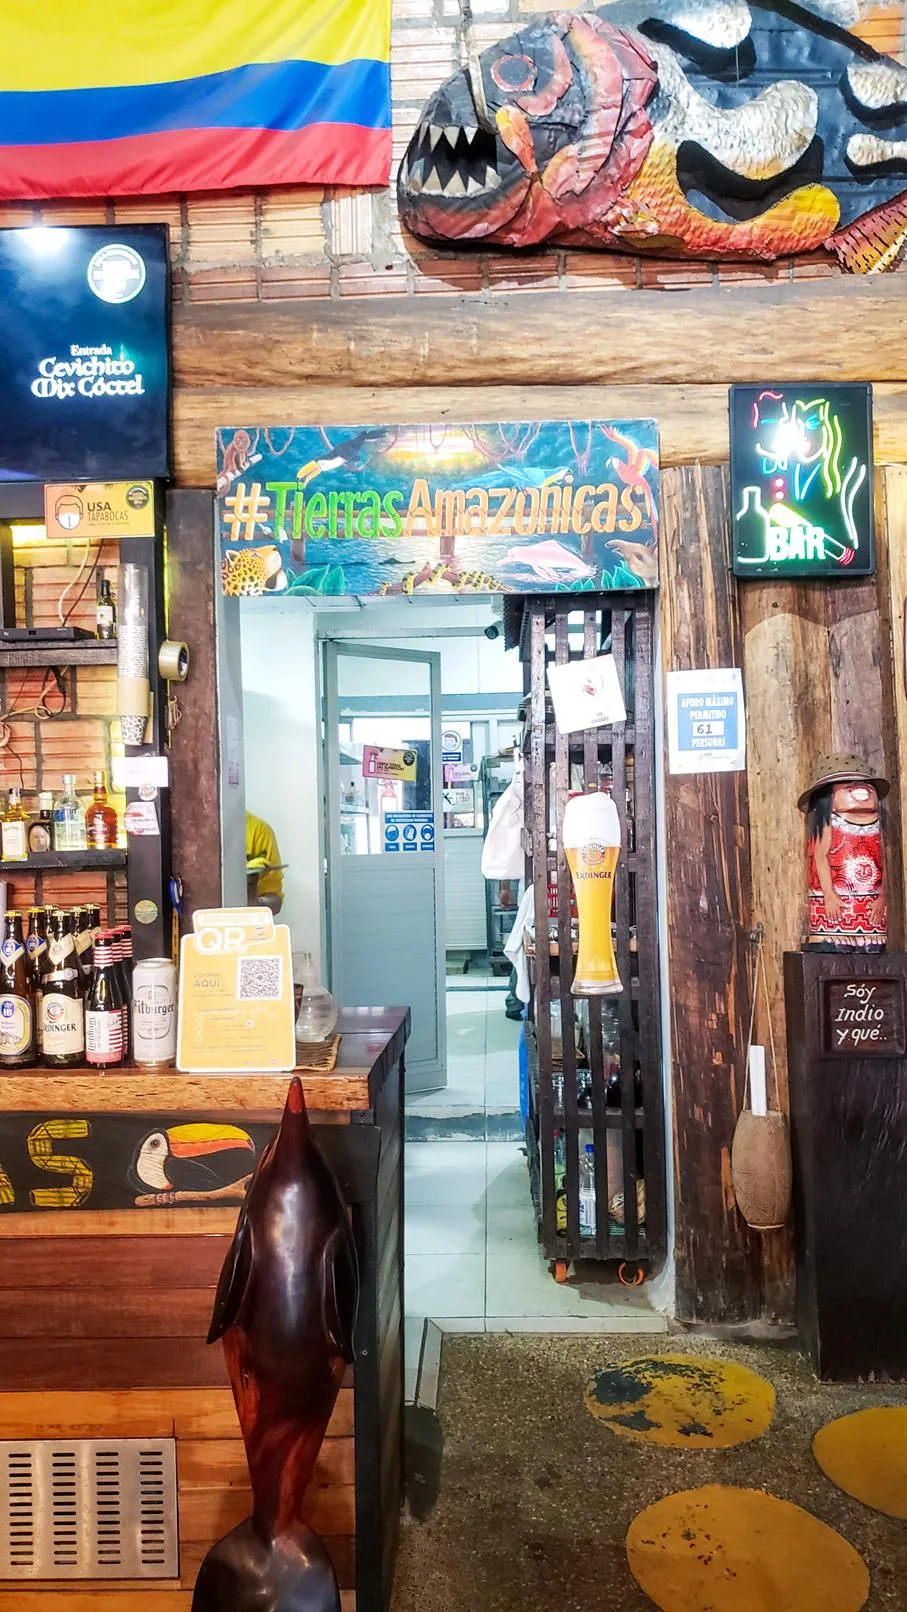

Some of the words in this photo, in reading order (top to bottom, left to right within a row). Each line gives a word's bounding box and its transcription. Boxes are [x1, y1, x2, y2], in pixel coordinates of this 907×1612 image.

[70, 344, 113, 356] Entrada
[30, 378, 76, 399] Mix
[87, 502, 112, 512] USA
[223, 478, 644, 541] #TierrasAmazonicas
[88, 511, 129, 521] TAPABOCAS
[770, 526, 826, 562] BAR
[681, 697, 704, 708] AFORO
[704, 694, 735, 707] MÁXIMO
[689, 709, 727, 720] PERMITIDO
[697, 724, 712, 734] 61
[691, 737, 726, 747] PERSONAS
[576, 871, 612, 880] ERDINGER
[195, 927, 248, 954] QR
[835, 1004, 884, 1021] Indio
[836, 1029, 849, 1045] y
